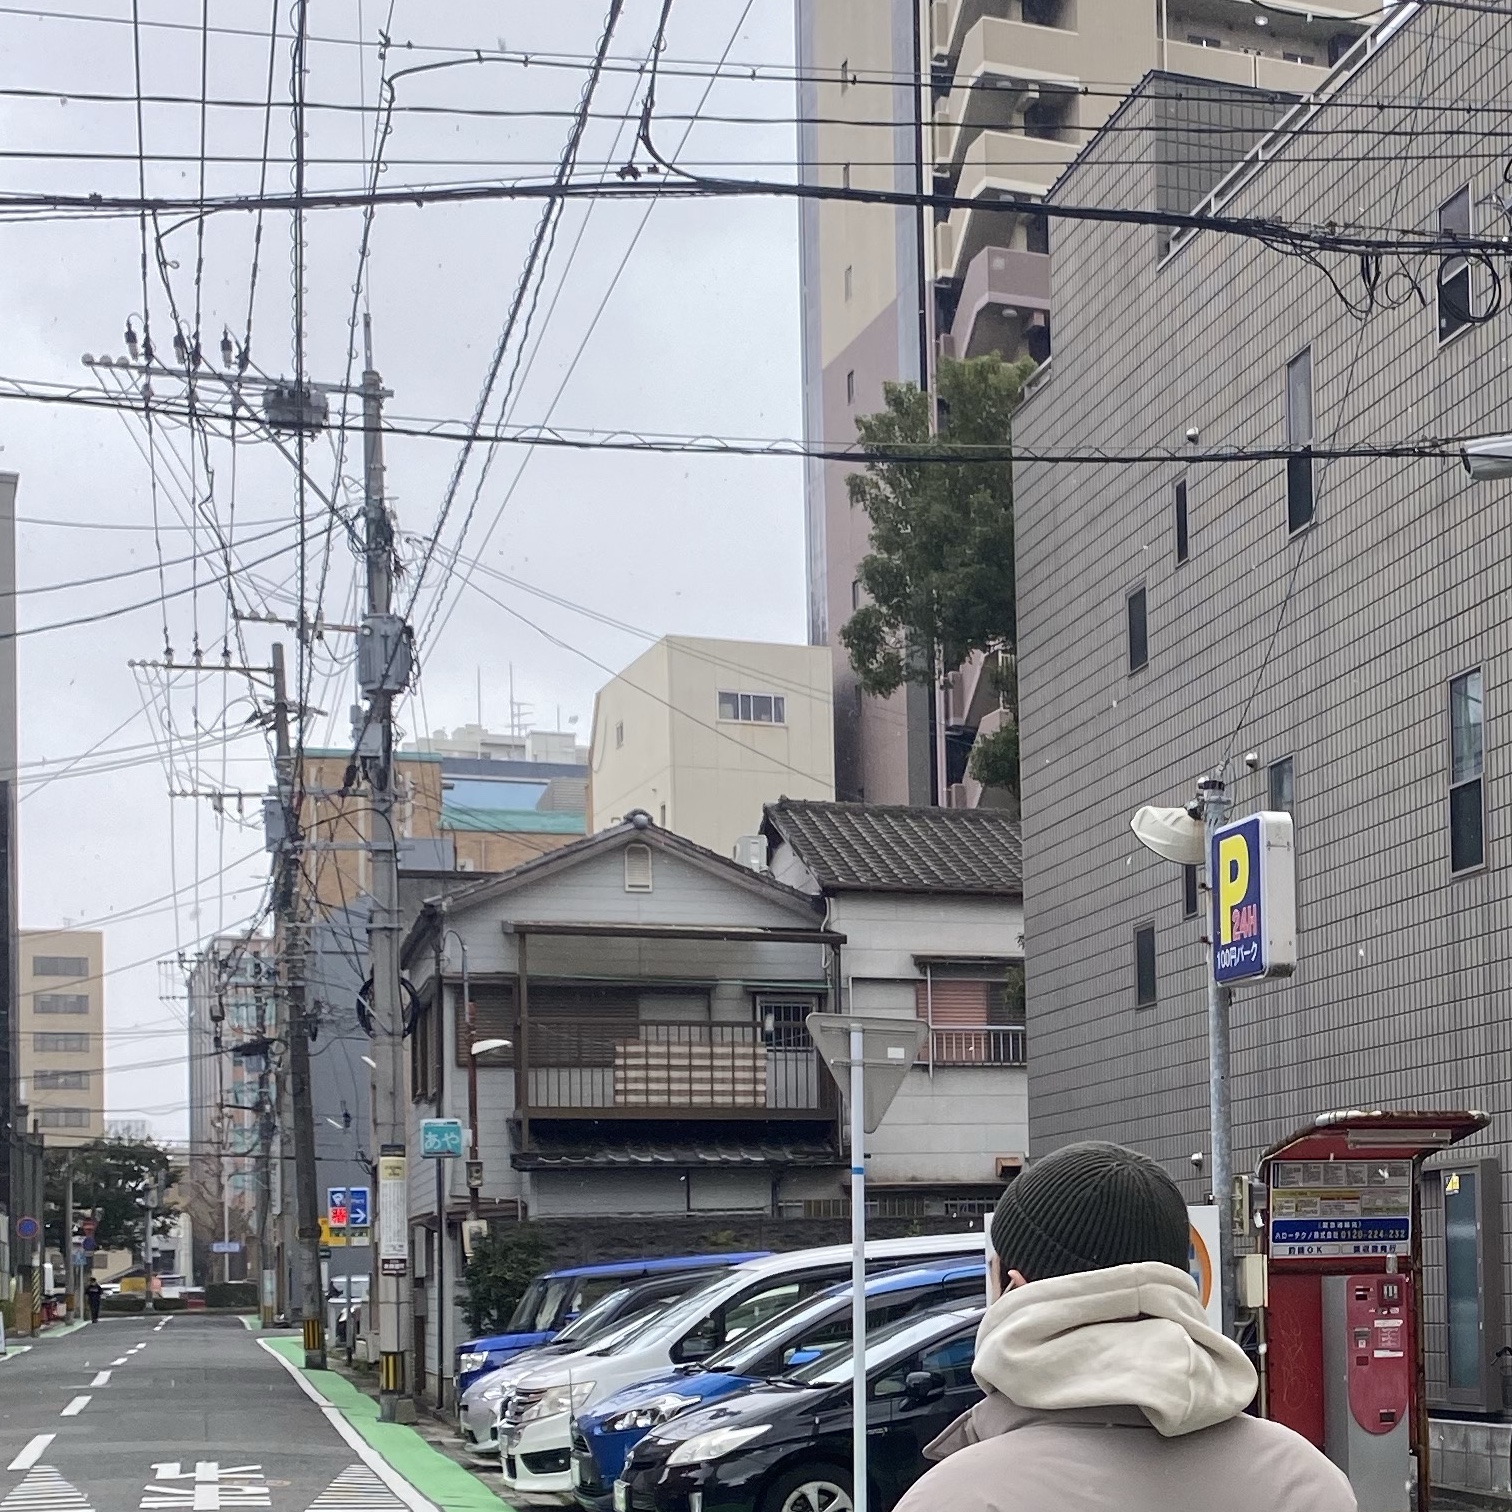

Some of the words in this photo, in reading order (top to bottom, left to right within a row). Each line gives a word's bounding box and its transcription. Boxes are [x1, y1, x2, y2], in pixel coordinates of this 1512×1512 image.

[1219, 833, 1250, 946] P
[1231, 903, 1257, 942] 24H
[1216, 940, 1258, 971] 100円パーク
[424, 1131, 460, 1150] あや
